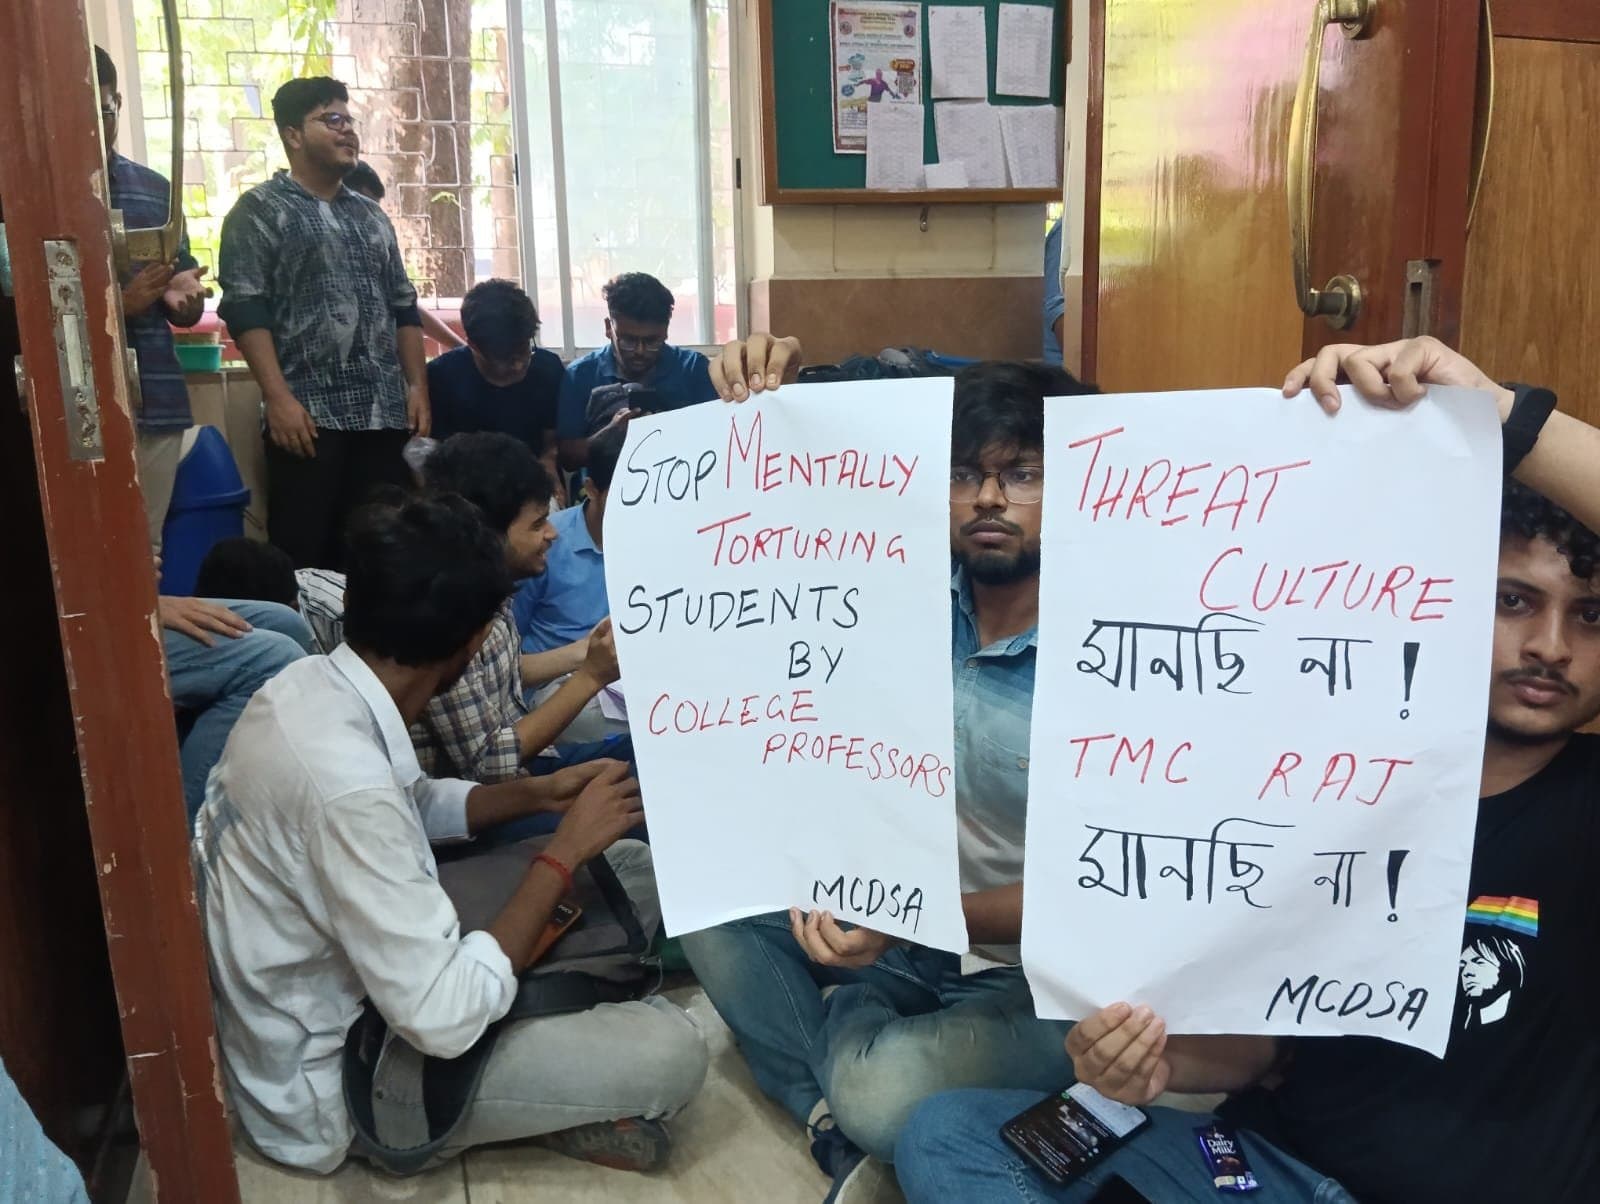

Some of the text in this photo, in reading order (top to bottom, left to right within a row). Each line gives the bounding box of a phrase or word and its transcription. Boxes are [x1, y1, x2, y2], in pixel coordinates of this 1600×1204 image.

[620, 410, 919, 506] STOP MENTALLY
[1068, 426, 1311, 531] THREAT
[697, 511, 906, 567] TORTURING
[619, 583, 860, 635] STUDENTS
[1199, 547, 1455, 621] CULTURE
[788, 641, 844, 684] BY
[649, 689, 819, 735] COLLEGE
[763, 732, 951, 797] PROFESSORS
[1070, 734, 1414, 806] TMC RAJ
[812, 875, 924, 934] MCDSA
[1265, 975, 1429, 1031] MCDSA
[1206, 1138, 1234, 1149] Dairy
[1211, 1145, 1237, 1155] Milk
